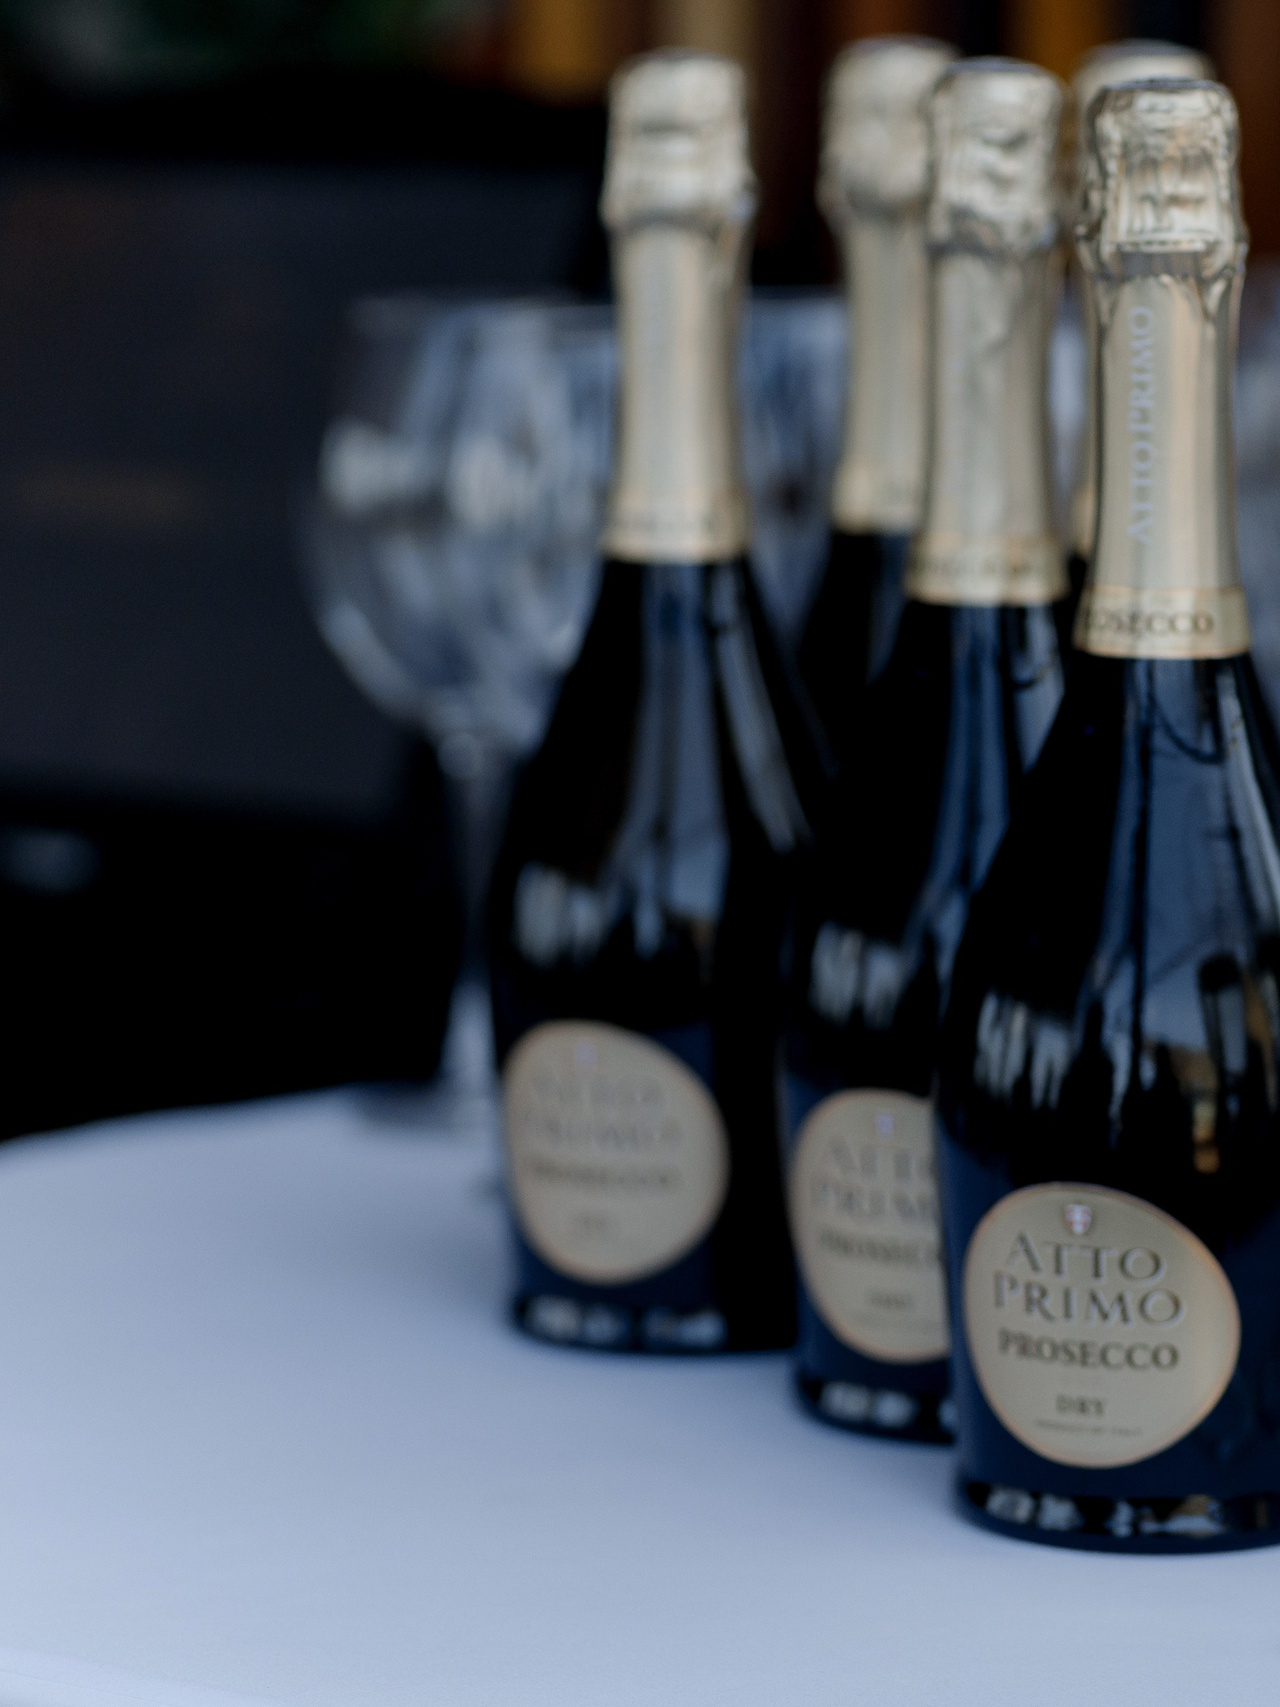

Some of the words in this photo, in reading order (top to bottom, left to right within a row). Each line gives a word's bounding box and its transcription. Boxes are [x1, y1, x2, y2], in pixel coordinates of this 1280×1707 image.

[1125, 305, 1154, 435] PRIMO
[1005, 1231, 1163, 1281] ATTO
[993, 1268, 1183, 1325] PRIMO
[999, 1328, 1181, 1371] PROSECCO
[1055, 1394, 1108, 1418] DRY
